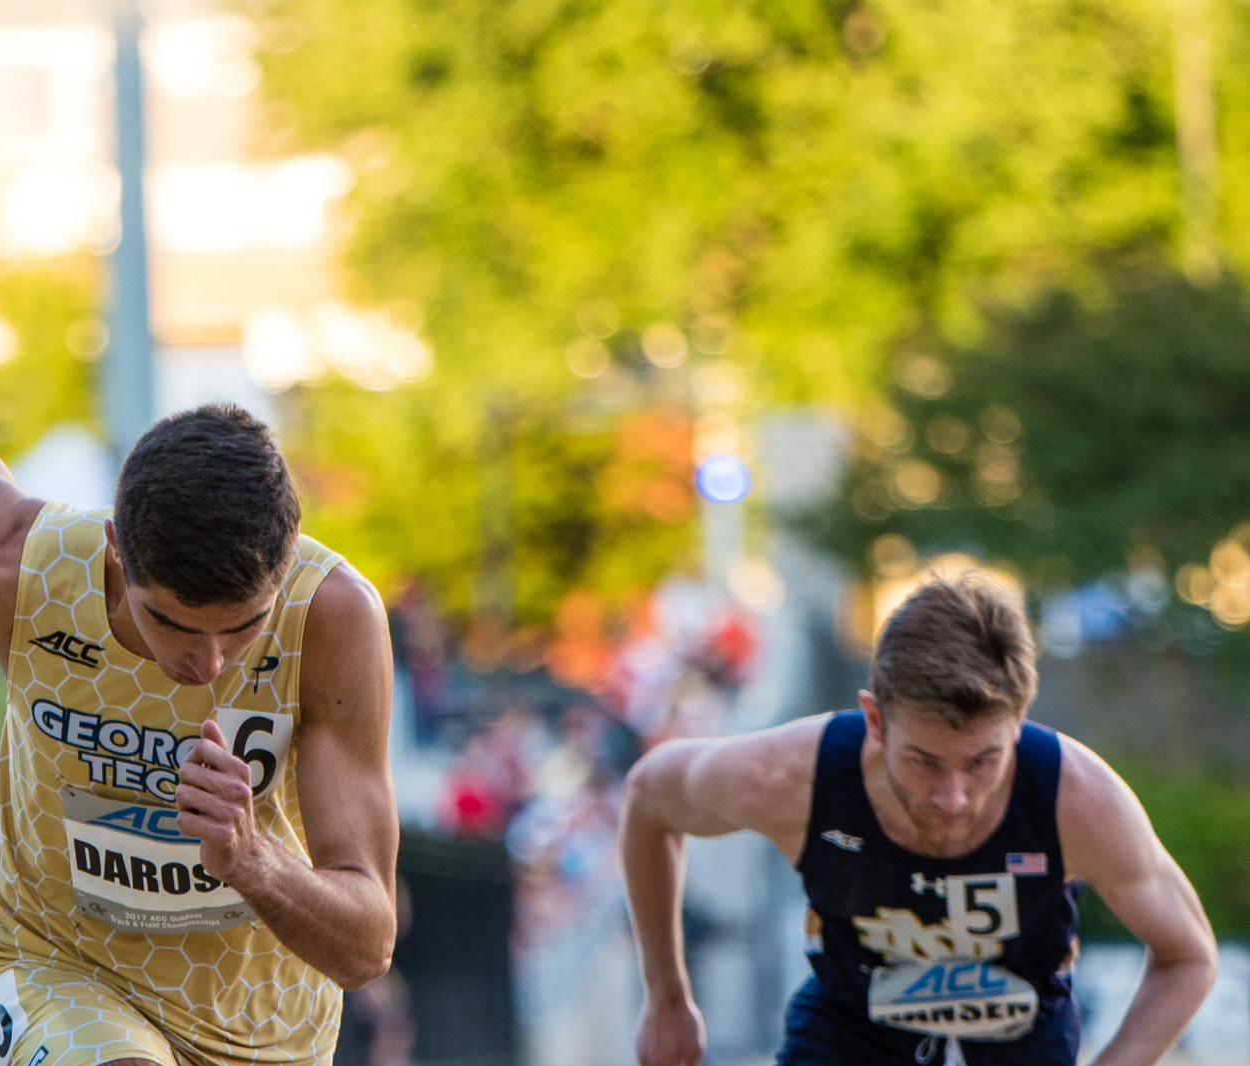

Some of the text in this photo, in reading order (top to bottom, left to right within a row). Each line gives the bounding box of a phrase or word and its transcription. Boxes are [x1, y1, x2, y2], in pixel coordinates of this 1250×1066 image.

[28, 631, 105, 669] ACC
[31, 698, 202, 768] GEOR
[233, 716, 277, 797] 6
[78, 753, 178, 802] TEC
[86, 806, 201, 844] AC
[74, 839, 230, 895] DAROS
[110, 913, 131, 927] Track
[140, 921, 160, 929] Field
[124, 911, 203, 923] 2017 ACC Outdoor
[964, 880, 1003, 935] 5
